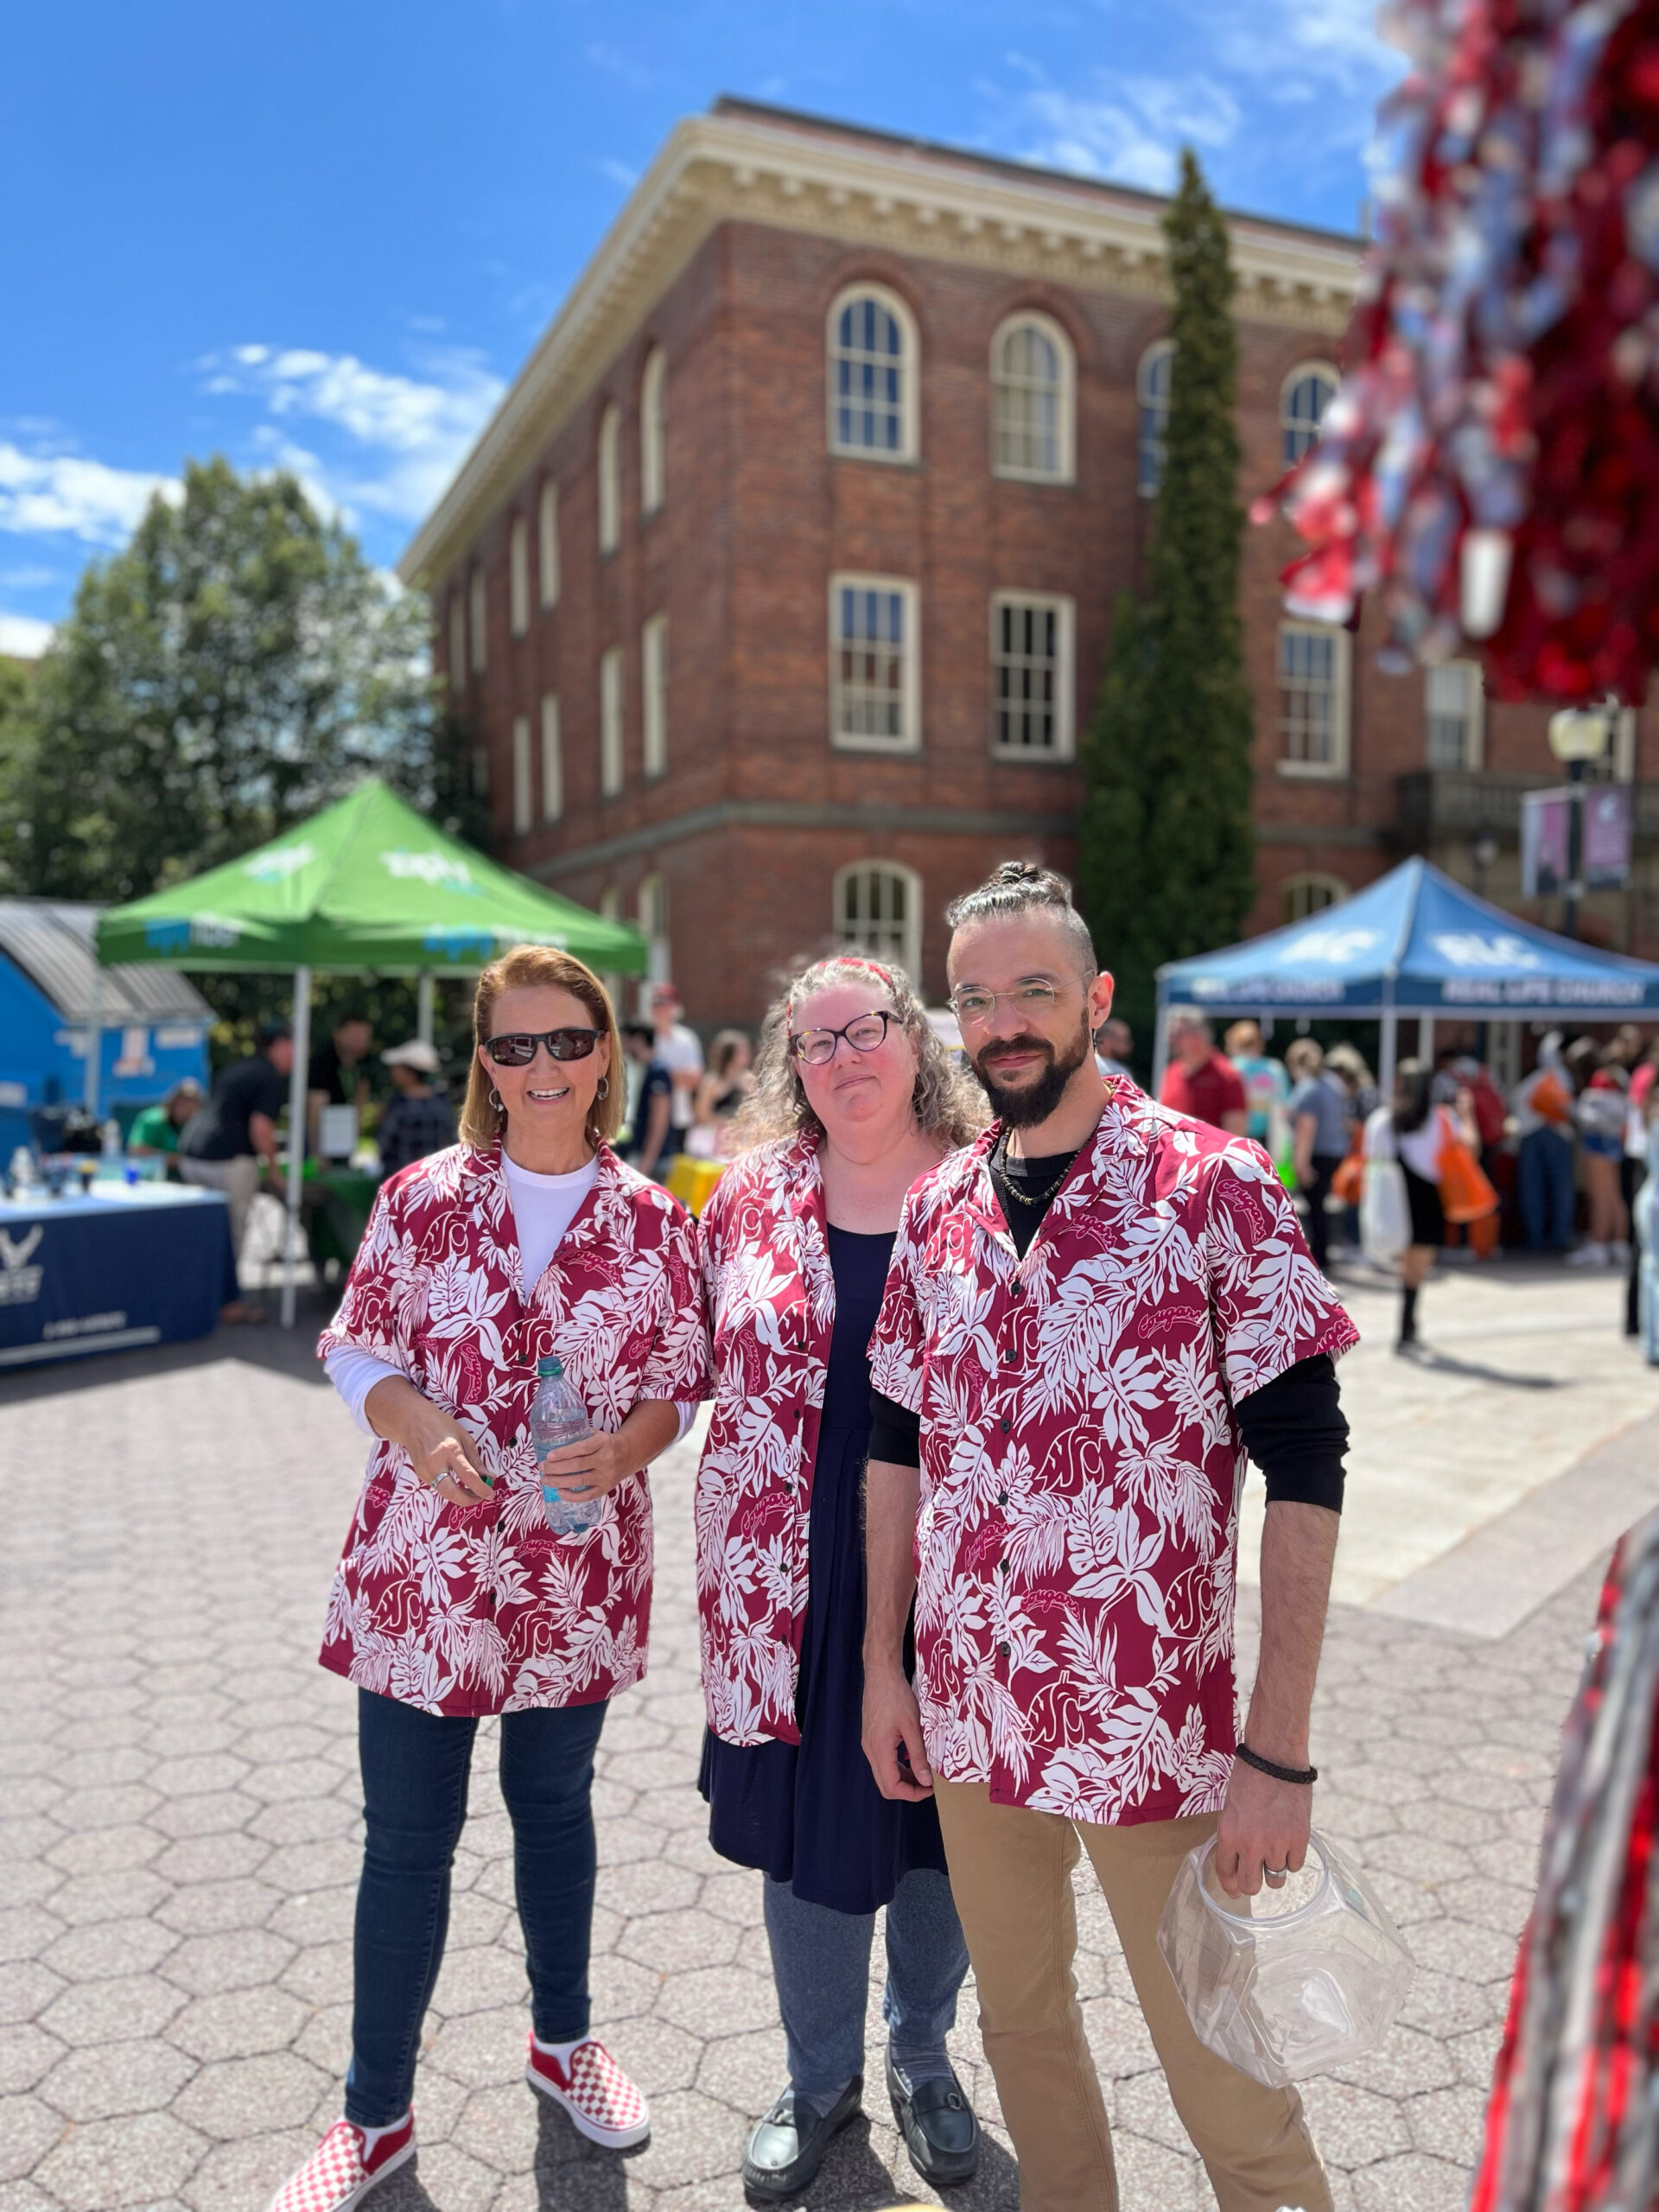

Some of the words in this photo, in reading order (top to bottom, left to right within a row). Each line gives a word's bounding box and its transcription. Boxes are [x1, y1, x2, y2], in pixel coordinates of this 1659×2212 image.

[1215, 1179, 1267, 1244] Cougars
[1136, 1306, 1202, 1338] Cougars
[461, 1344, 482, 1403] Cougars
[739, 1329, 760, 1395] Cougars
[741, 1492, 796, 1539] Cougars
[513, 1539, 564, 1562] Cougars
[1020, 1589, 1079, 1621] Cougars
